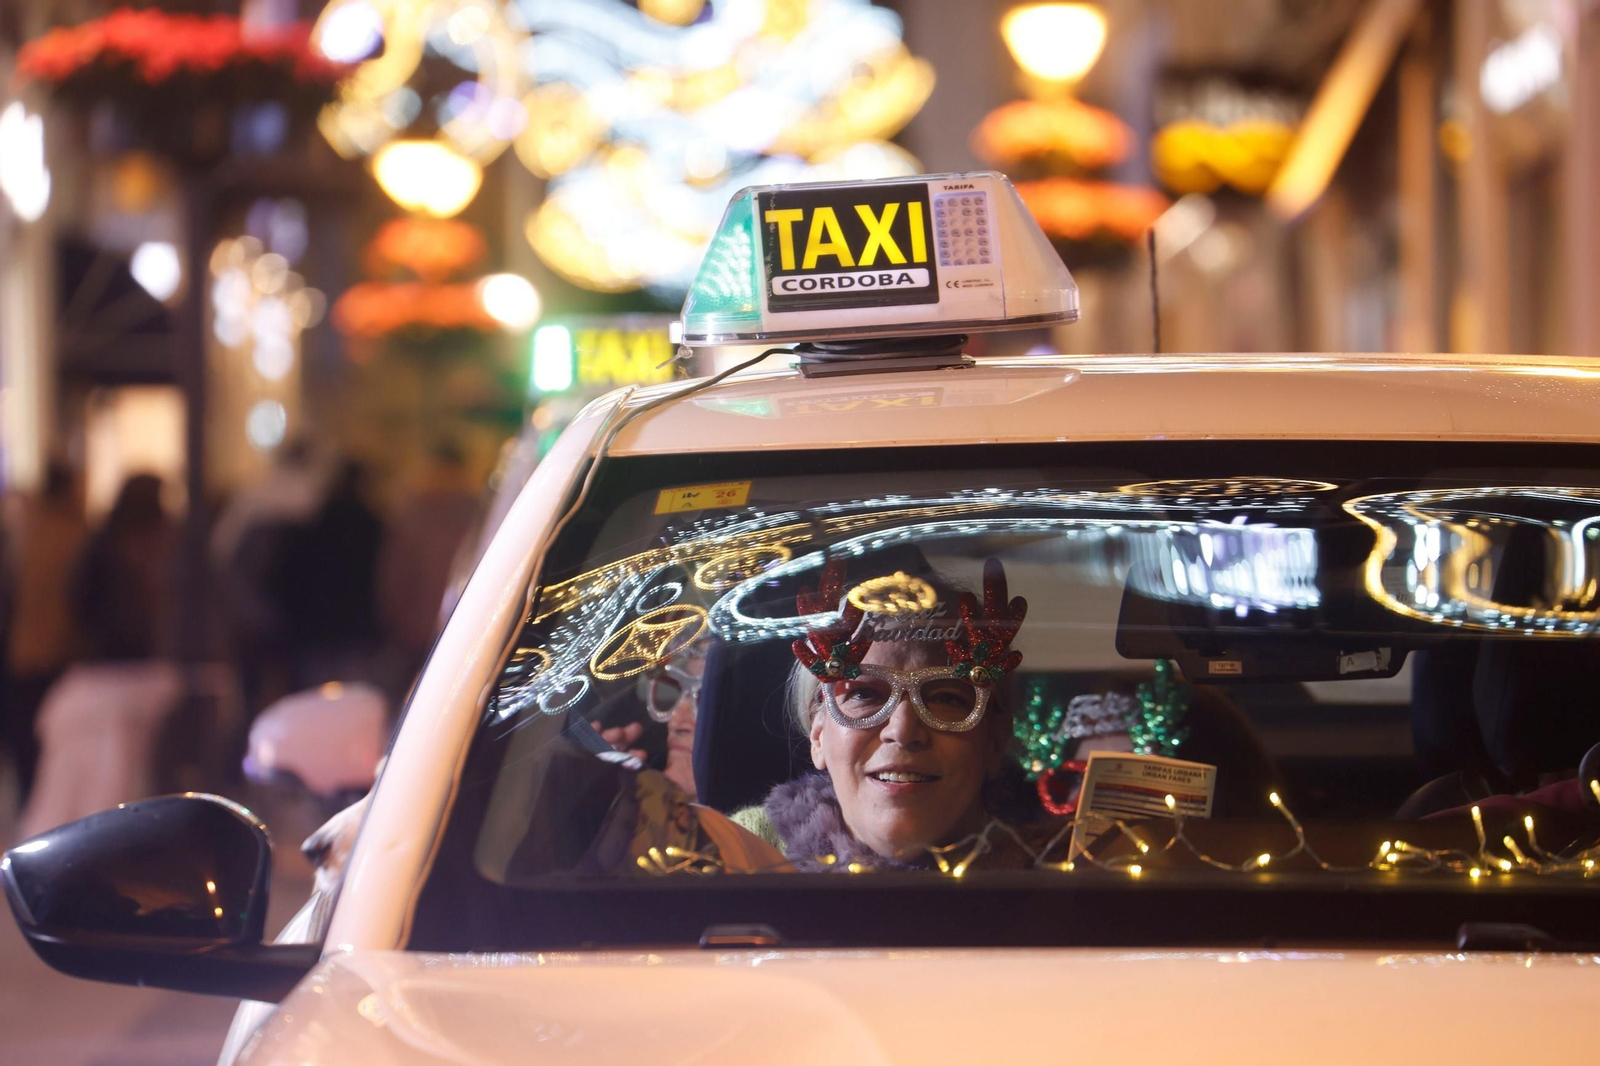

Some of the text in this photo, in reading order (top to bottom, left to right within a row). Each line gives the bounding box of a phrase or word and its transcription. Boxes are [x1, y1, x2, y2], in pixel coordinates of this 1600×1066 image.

[765, 201, 928, 271] TAXI
[781, 272, 915, 292] CORDOBA
[715, 490, 736, 499] 26
[1143, 764, 1172, 774] TARIFAS
[1142, 771, 1167, 780] URBAN
[1168, 775, 1192, 784] FARES
